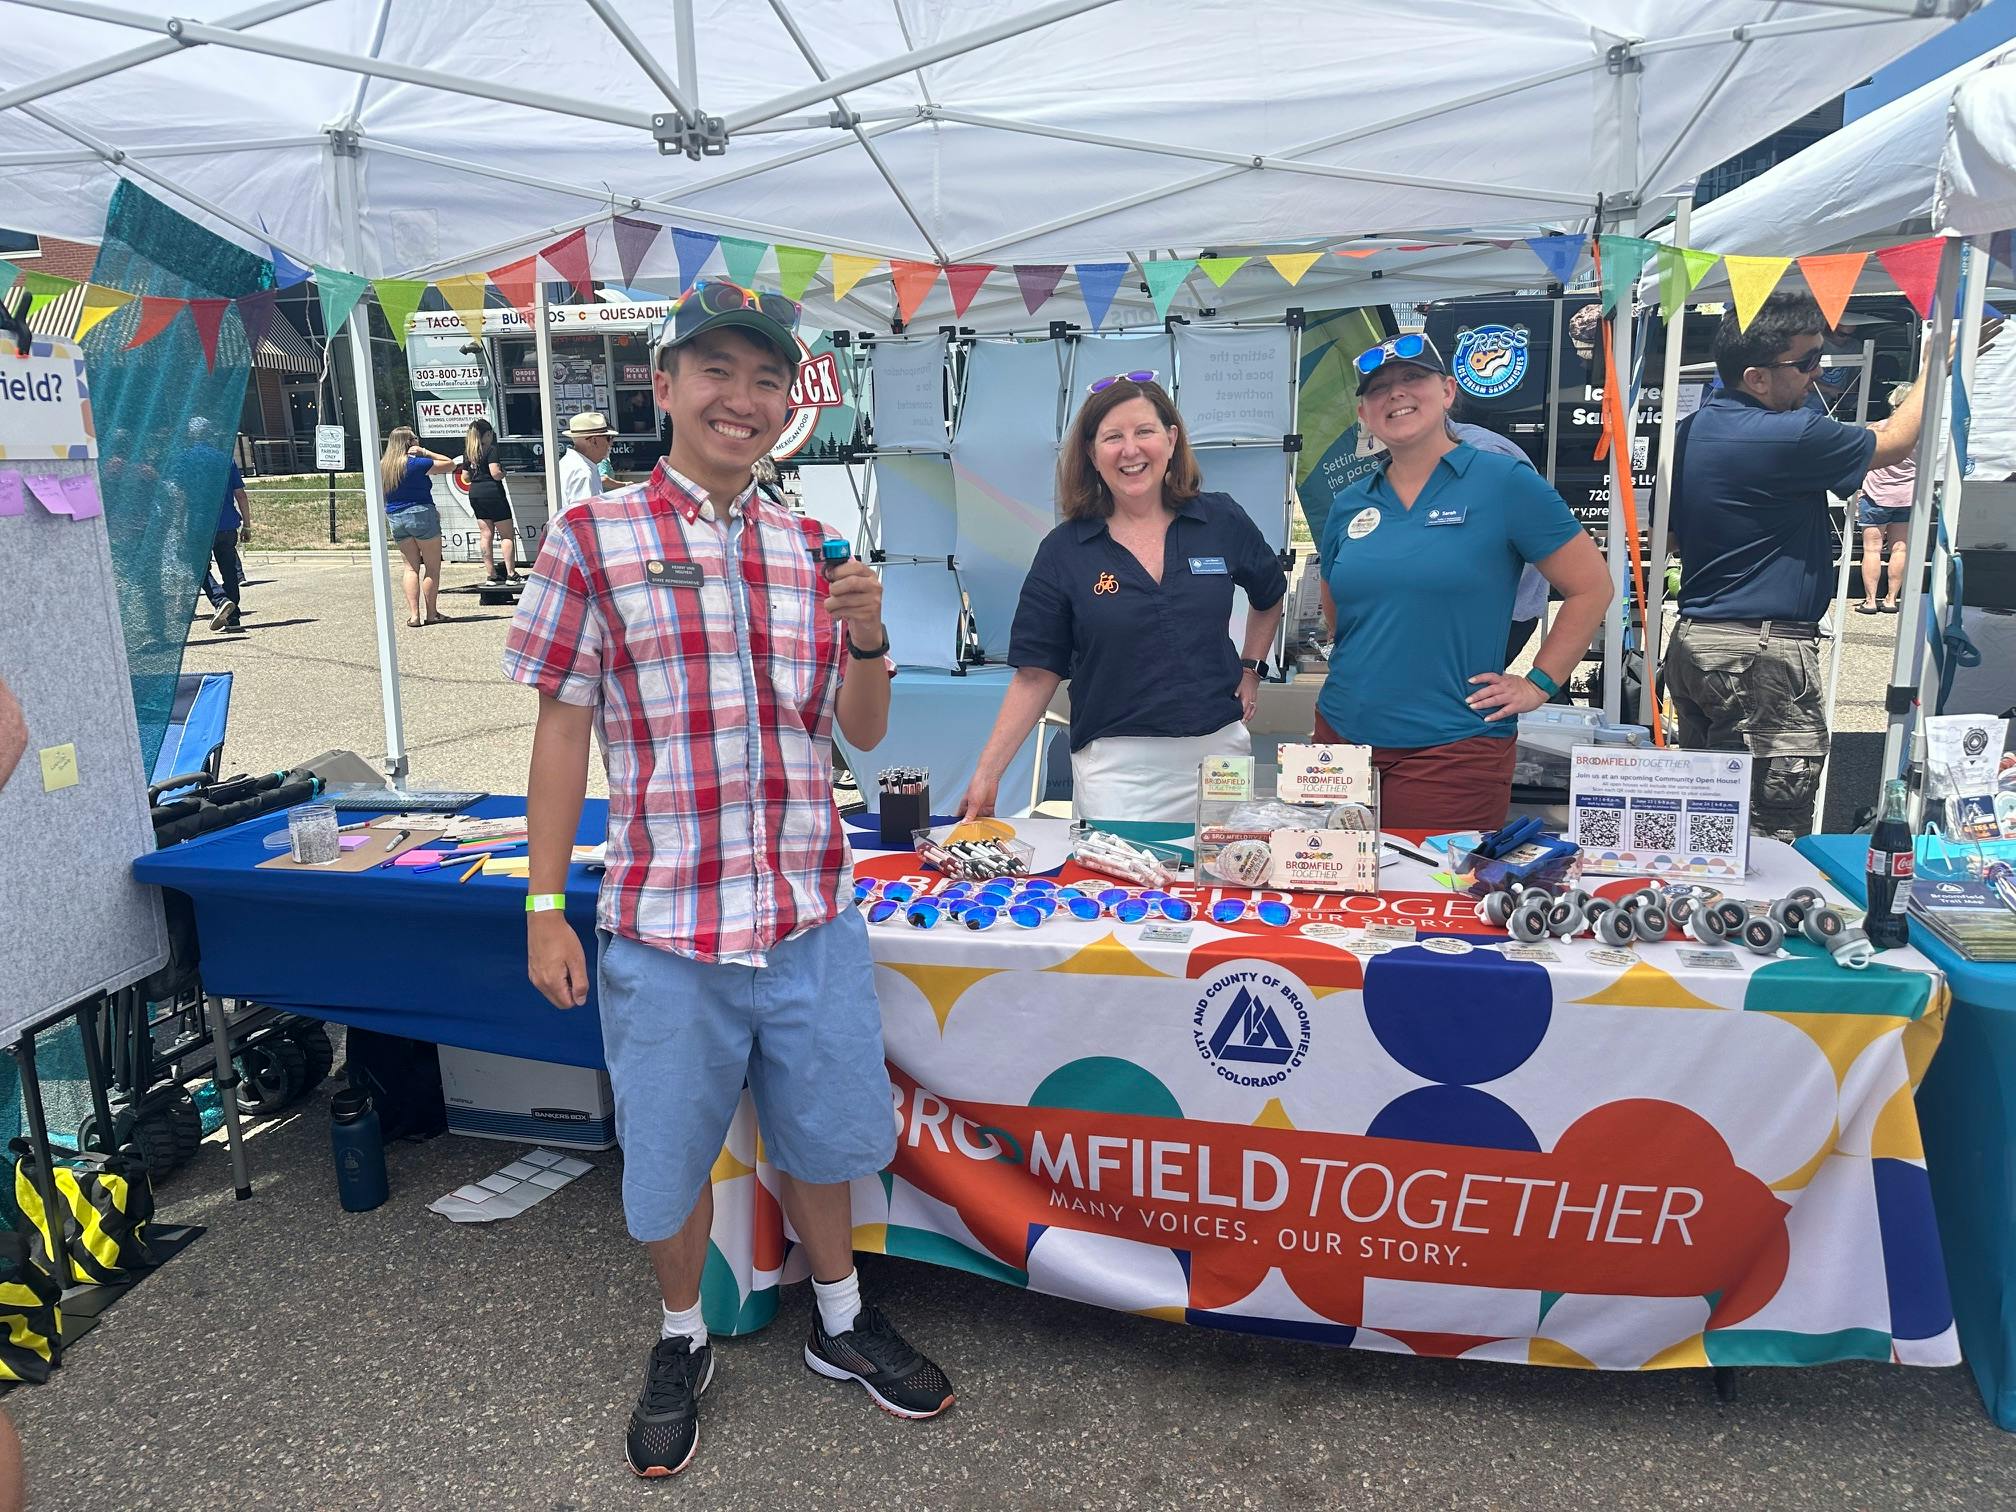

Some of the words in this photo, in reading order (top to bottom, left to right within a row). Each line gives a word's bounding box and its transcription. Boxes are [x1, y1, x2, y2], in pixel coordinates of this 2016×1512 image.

[502, 311, 566, 326] BURROS
[600, 306, 669, 320] QUESADIL
[1456, 329, 1528, 357] PRESS
[416, 368, 484, 380] 303-800-7157
[0, 371, 62, 402] ield?
[1584, 384, 1605, 401] Ic
[421, 404, 441, 416] WE
[443, 403, 487, 416] CATER!
[775, 430, 799, 451] MEXICAN
[797, 413, 809, 432] FOOD
[1322, 453, 1364, 475] Settin
[1327, 475, 1344, 489] the
[1346, 461, 1379, 483] pace
[1576, 756, 1637, 767] BROOMFIELD
[1637, 758, 1691, 769] TOGETHER
[1296, 775, 1353, 785] BROOMFIELD
[1302, 784, 1348, 793] TOGETHER
[1620, 774, 1653, 782] upcoming
[1654, 776, 1695, 784] Community
[1695, 777, 1715, 785] Open
[1285, 860, 1343, 871] BROOMFIELD
[1291, 870, 1338, 879] TOGETHER
[1360, 915, 1464, 929] STORY.
[1205, 972, 1258, 998] COUNTY
[1261, 975, 1281, 988] OF
[1193, 999, 1208, 1026] AND
[1280, 985, 1311, 1068] BROOMFIELD
[1193, 1030, 1211, 1059] CITY
[1217, 1066, 1287, 1087] COLORADO
[534, 1111, 570, 1120] BANKERS
[570, 1113, 587, 1121] BOX
[1299, 1157, 1704, 1246] TOGETHER
[1049, 1189, 1125, 1222] MANY
[1139, 1209, 1259, 1246] VOICES.
[1278, 1228, 1342, 1256] OUR
[1359, 1236, 1469, 1267] STORY.
